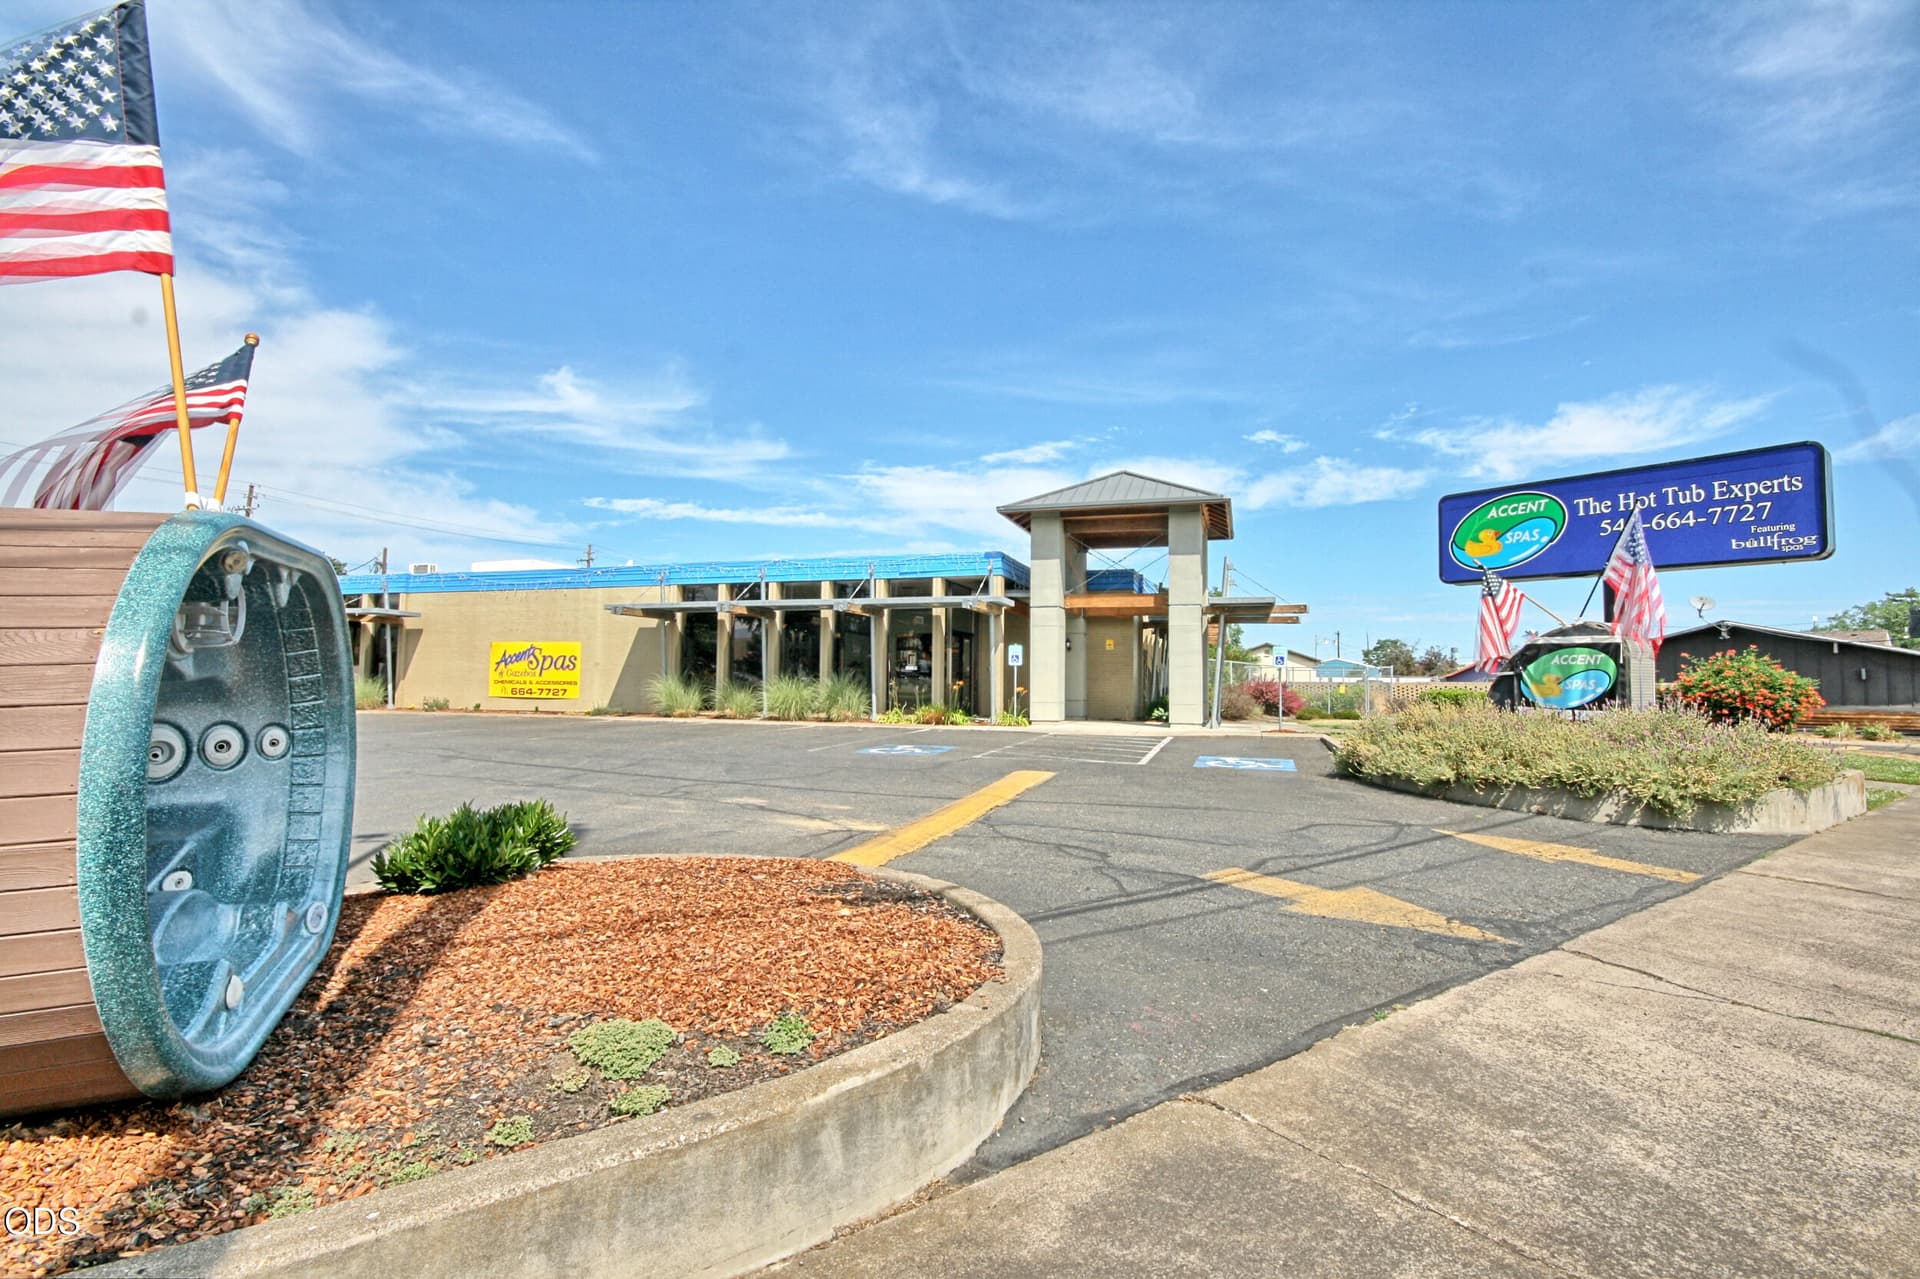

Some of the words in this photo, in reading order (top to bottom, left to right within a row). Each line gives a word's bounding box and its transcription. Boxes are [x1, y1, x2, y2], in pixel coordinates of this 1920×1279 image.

[1573, 497, 1612, 516] The
[1617, 491, 1657, 511] Hot
[1662, 486, 1705, 506] Tub
[1712, 474, 1803, 502] Experts
[1487, 498, 1550, 519] ACCENT
[1599, 501, 1772, 536] 54-664-7727
[1750, 522, 1796, 533] Featuring
[1504, 528, 1541, 544] SPAS
[1731, 532, 1819, 550] bullfrog
[1781, 544, 1804, 552] spas
[494, 643, 536, 672] Accent
[527, 647, 577, 677] Spas
[1551, 654, 1604, 666] ACCENT
[510, 687, 568, 697] 664-7727
[1564, 679, 1596, 690] SPAS
